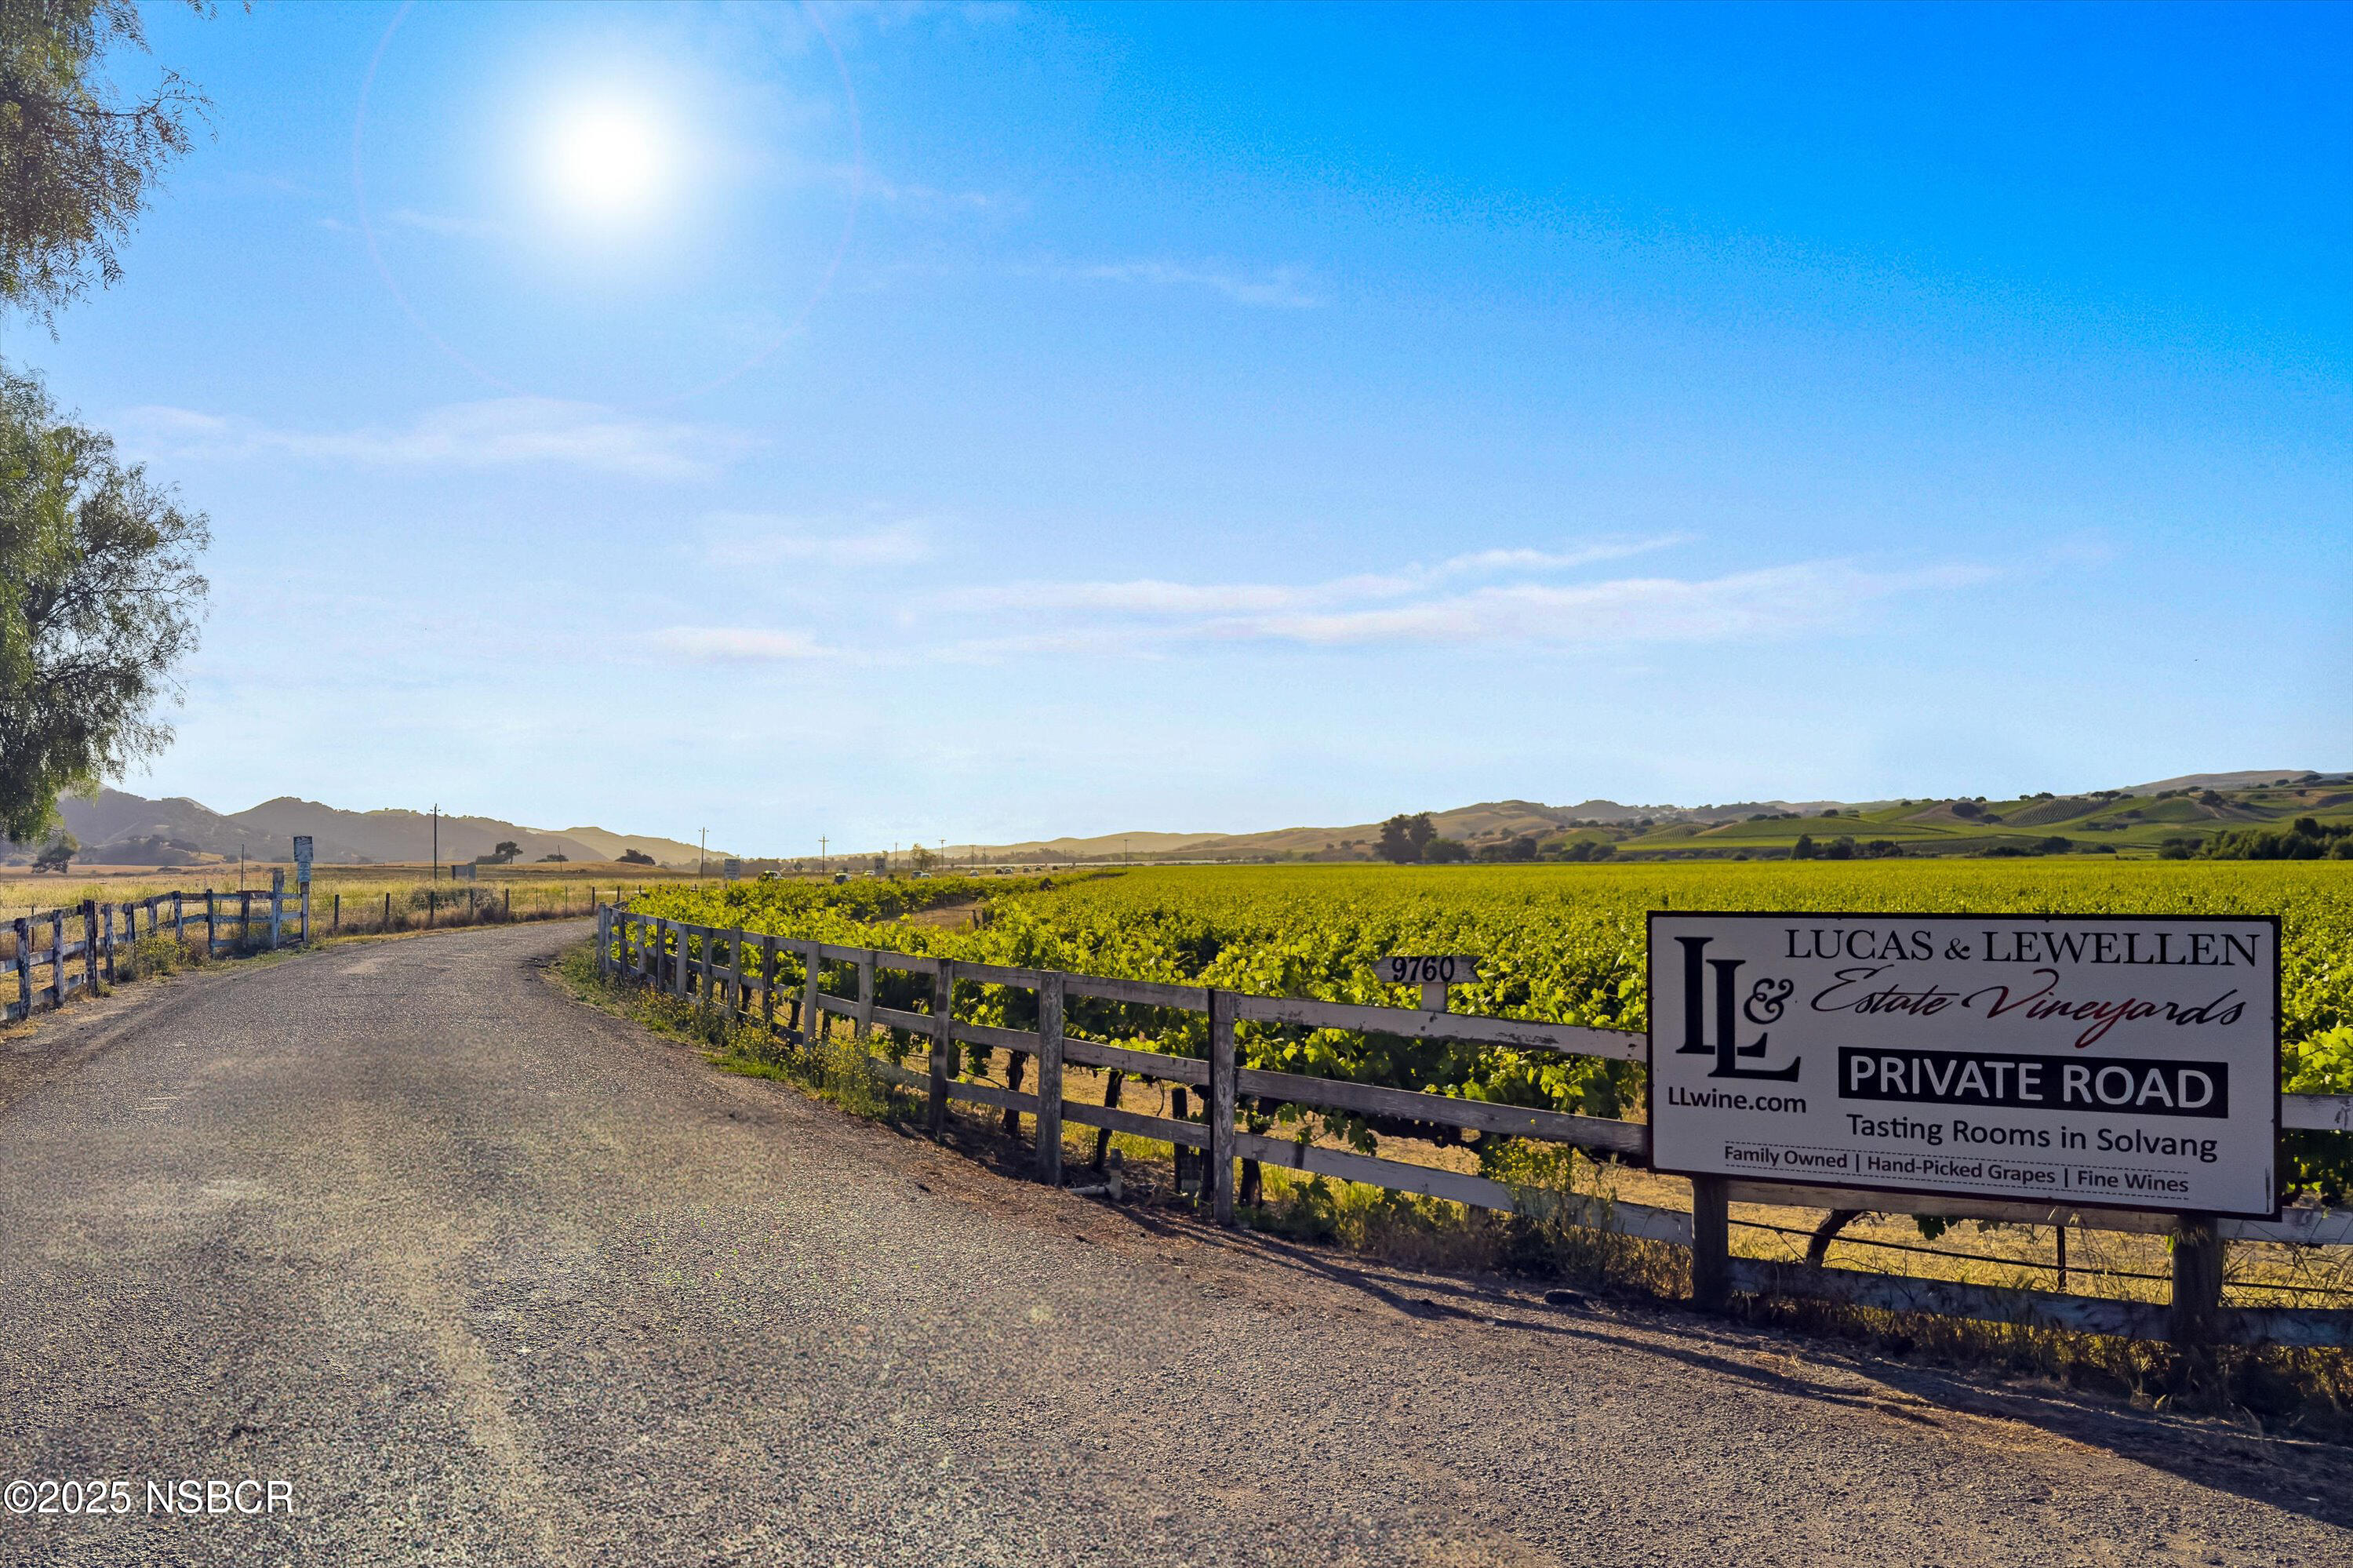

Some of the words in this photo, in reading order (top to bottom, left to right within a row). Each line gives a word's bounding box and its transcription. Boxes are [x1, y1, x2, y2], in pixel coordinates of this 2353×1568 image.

[1391, 955, 1455, 982] 9760
[1784, 929, 1933, 961] LUCAS
[1944, 937, 1971, 961] &
[1982, 930, 2260, 967] LEWELLEN
[1810, 964, 1960, 1016] Estate
[1961, 968, 2246, 1049] Vineyards
[1667, 1086, 1806, 1114] LLwine.com
[1850, 1055, 2043, 1101] PRIVATE
[2063, 1064, 2213, 1108] ROAD
[1846, 1113, 1943, 1146] Tasting
[1953, 1119, 2051, 1148] Rooms
[2060, 1126, 2086, 1150] in
[2097, 1128, 2218, 1163] Solvang
[1725, 1146, 1780, 1166] Family
[1784, 1150, 1847, 1169] Owned
[1867, 1155, 1982, 1178] Hand-Picked
[1988, 1164, 2056, 1185] Grapes
[2078, 1170, 2118, 1188] Fine
[2124, 1173, 2189, 1192] Wines
